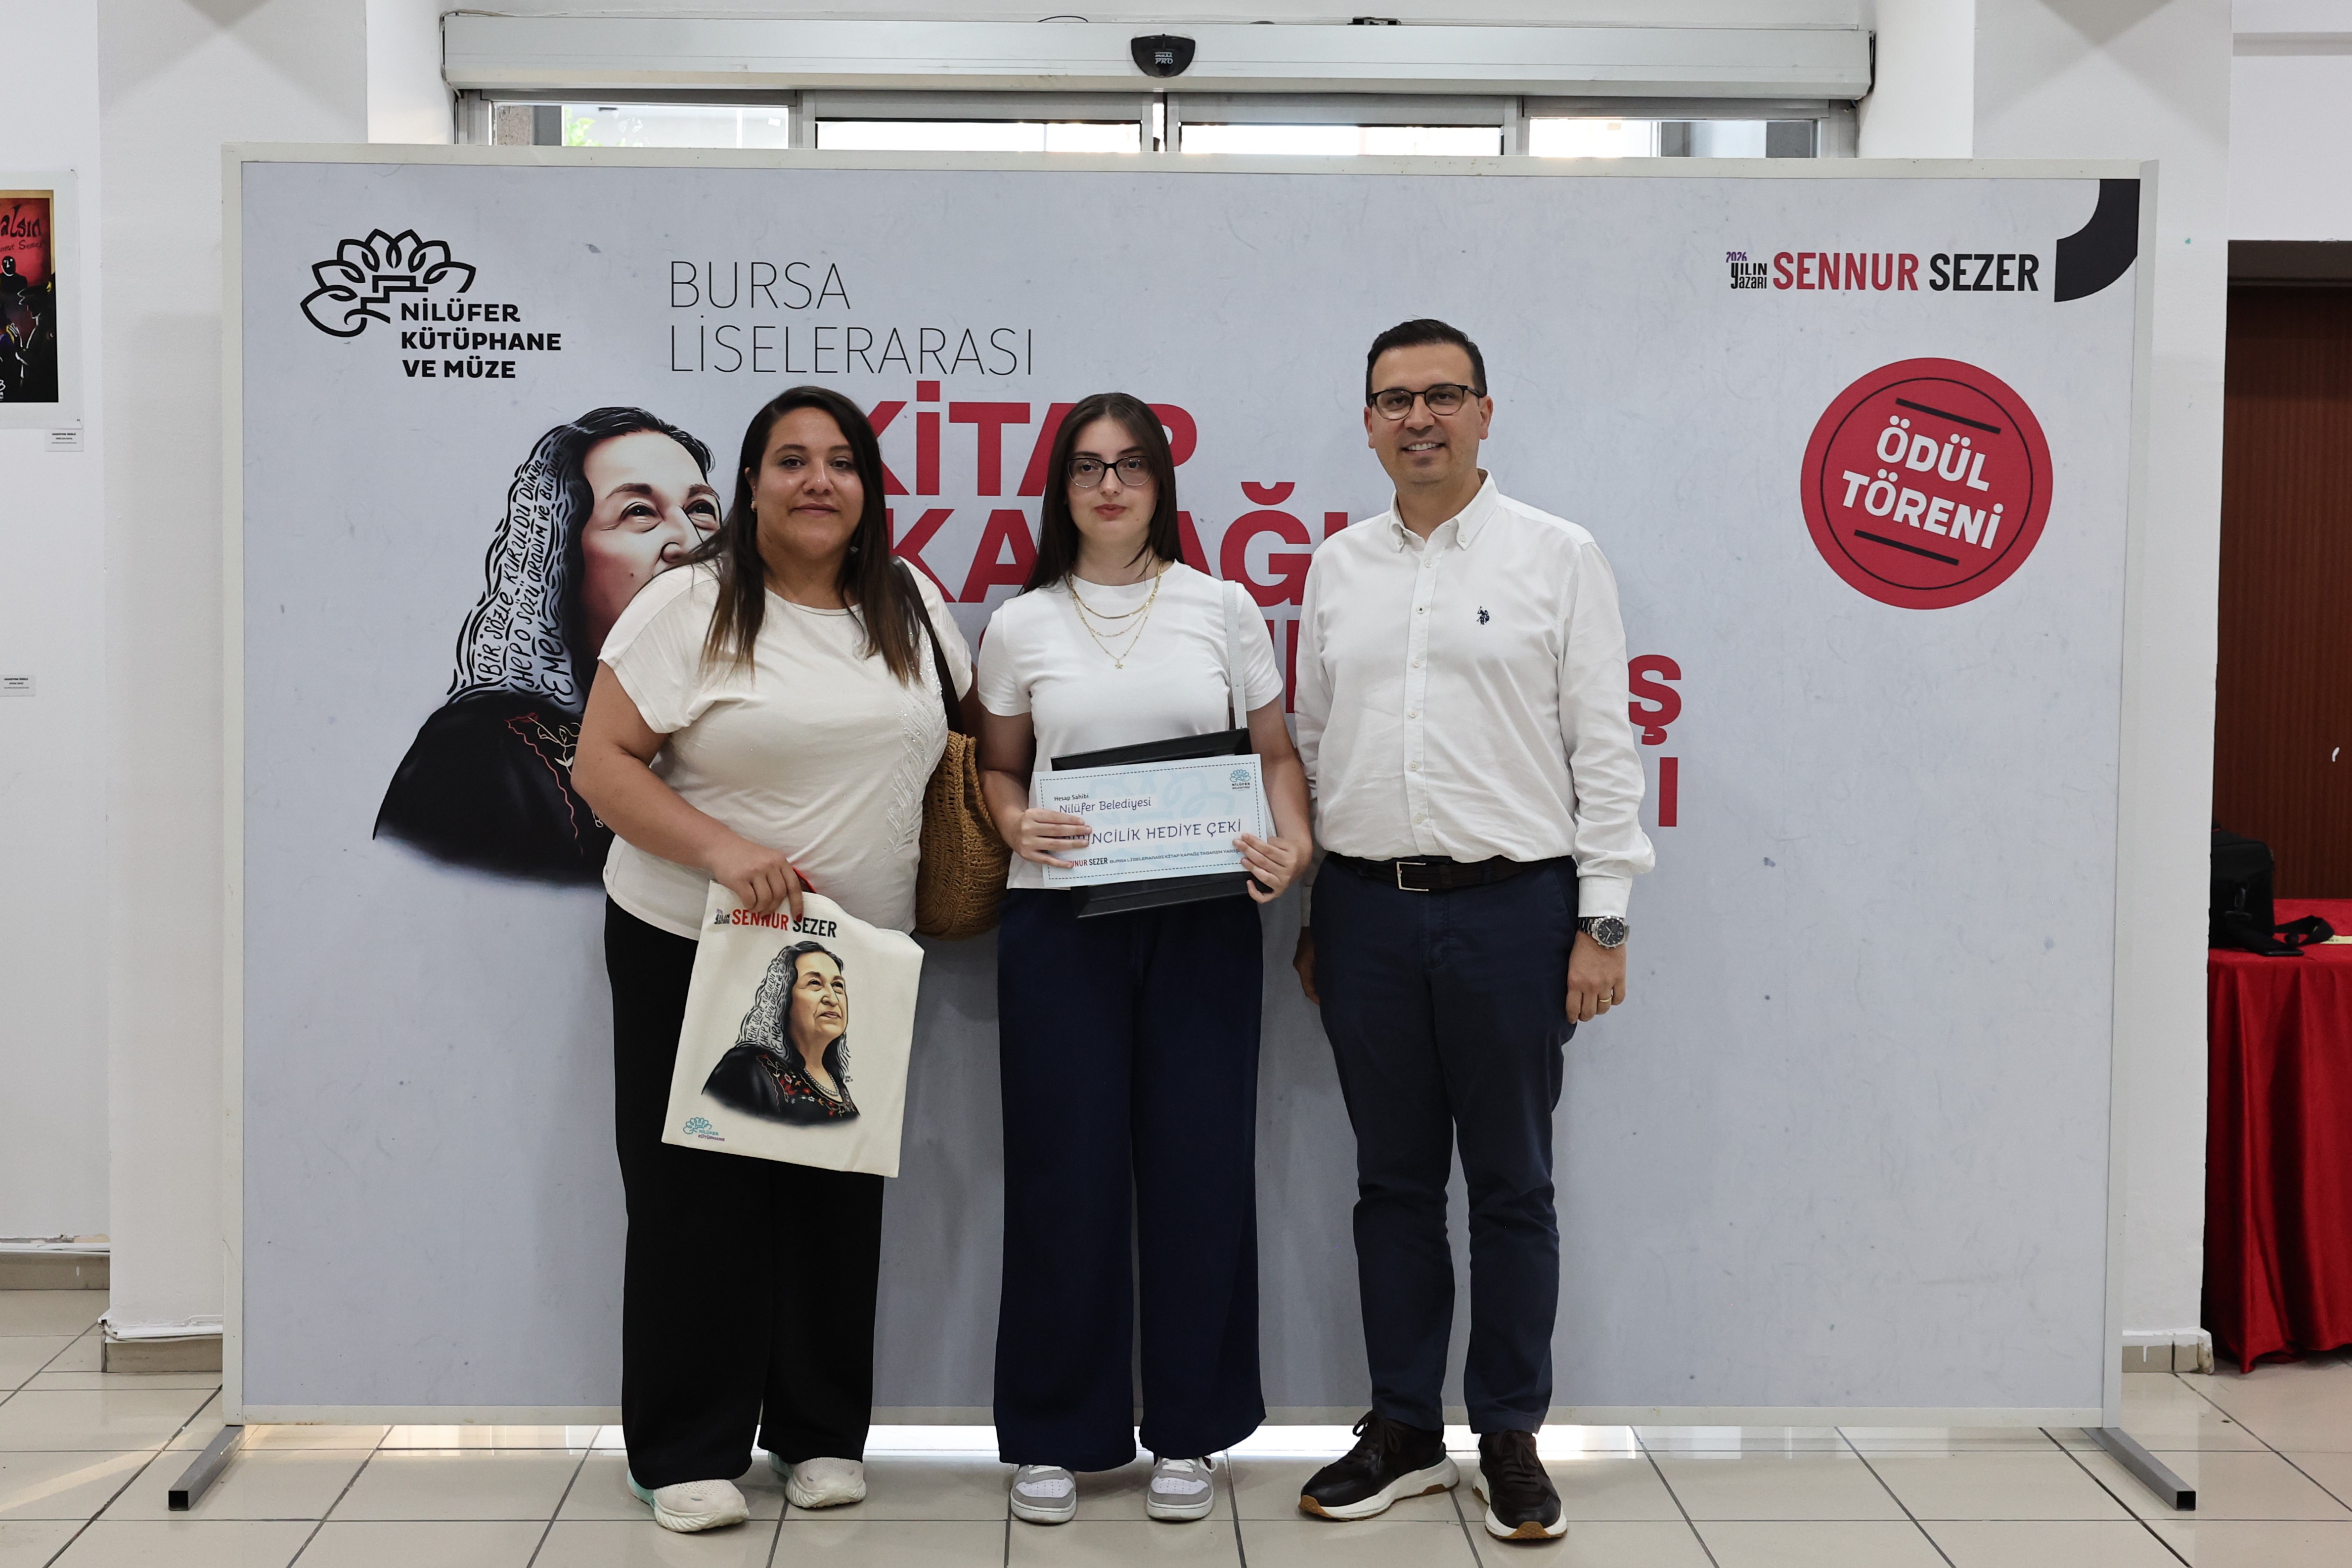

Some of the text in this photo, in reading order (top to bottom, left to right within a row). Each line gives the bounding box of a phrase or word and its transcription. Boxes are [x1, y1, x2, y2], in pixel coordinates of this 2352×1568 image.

[0, 204, 42, 237] alsın
[1726, 251, 1747, 263] 2026
[670, 261, 851, 309] BURSA
[1773, 252, 2039, 291] SENNUR SEZER
[401, 298, 520, 322] NİLÜFER
[401, 326, 561, 350] KÜTÜPHANE
[670, 315, 1031, 376] LİSELERARASI
[402, 355, 516, 378] VE MÜZE
[1877, 415, 1990, 491] ÖDÜL
[1842, 469, 2003, 549] TÖRENİ
[503, 503, 531, 584] KURULDU
[1060, 797, 1151, 815] Nilüfer Belediyesi
[1146, 824, 1201, 839] HEDİYE
[1207, 819, 1241, 837] ÇEKİ
[1089, 857, 1108, 866] SEZER
